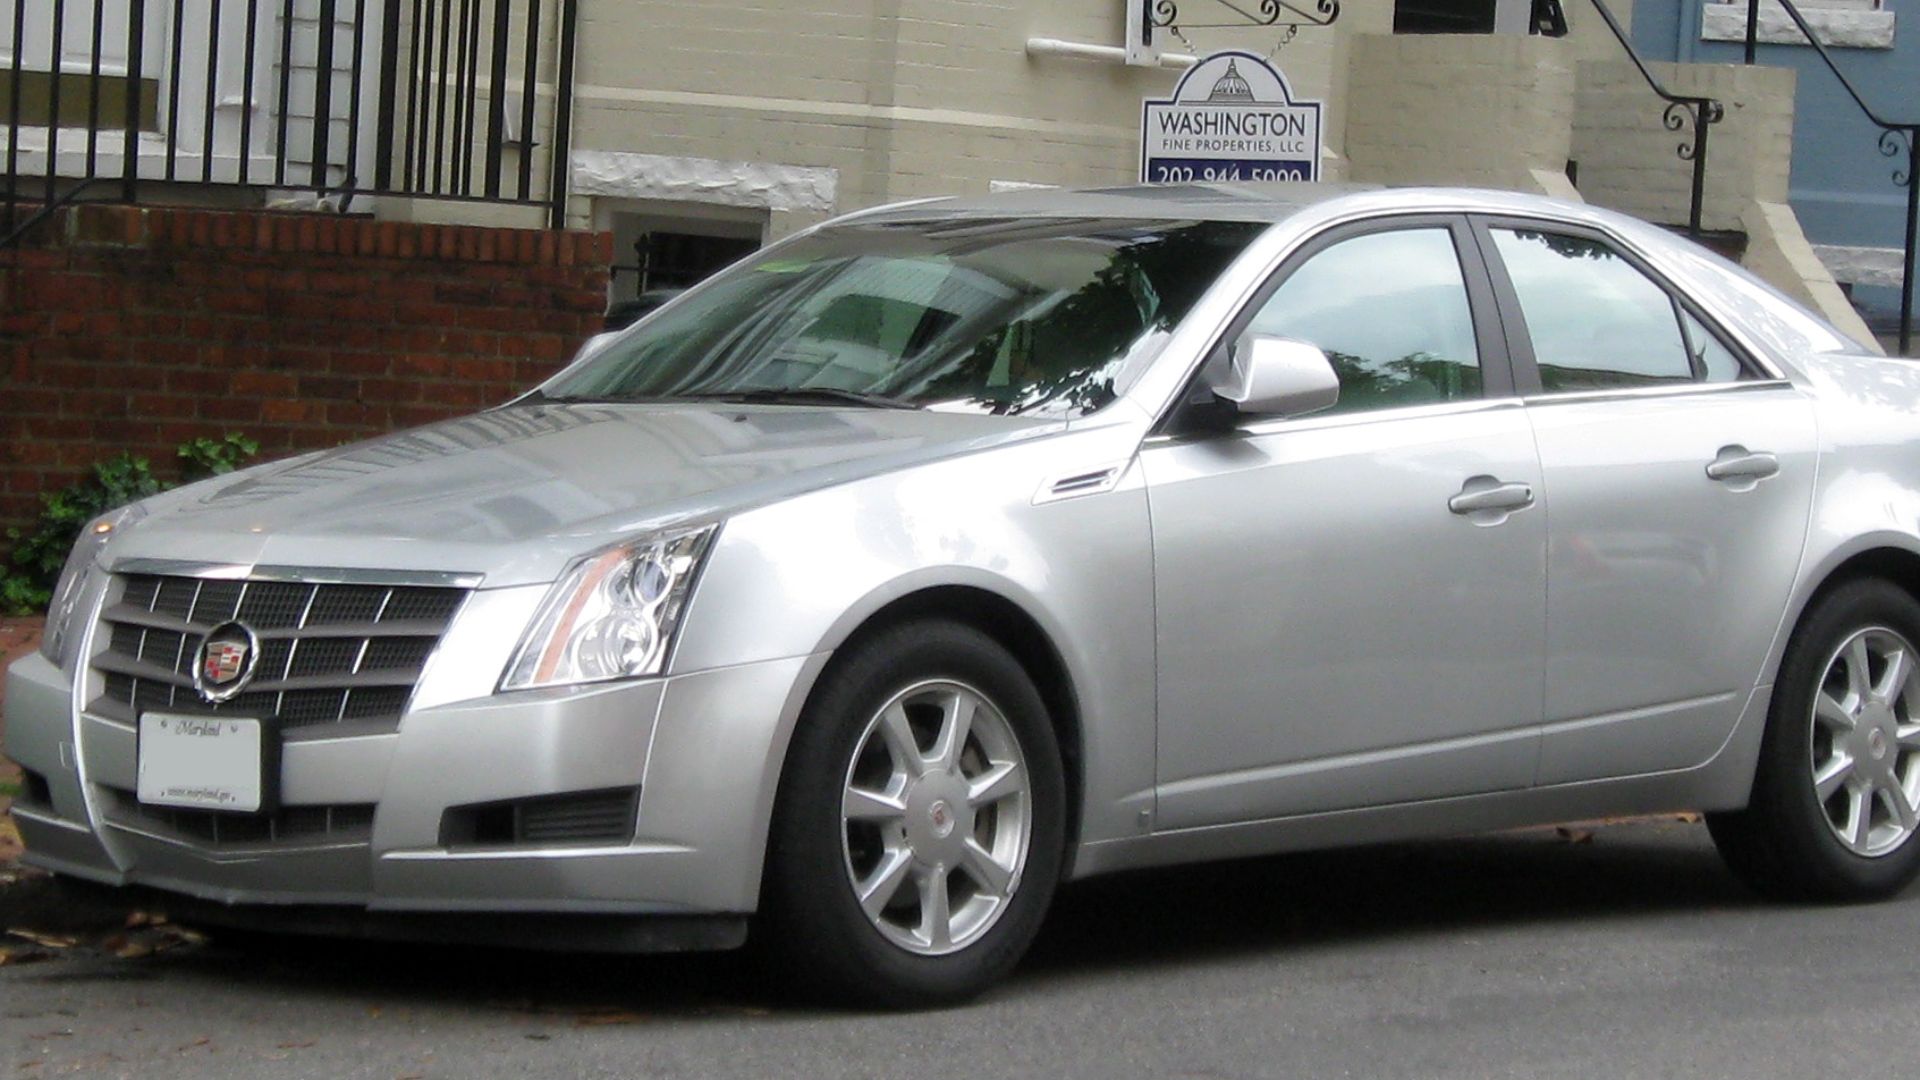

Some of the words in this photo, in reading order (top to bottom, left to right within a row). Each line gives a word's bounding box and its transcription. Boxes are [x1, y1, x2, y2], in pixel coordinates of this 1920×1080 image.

[1158, 111, 1305, 137] WASHINGTON
[1162, 139, 1191, 151] FINE
[1196, 139, 1276, 153] PROPERTIES,
[1279, 141, 1304, 153] LLC
[1157, 166, 1194, 182] 202
